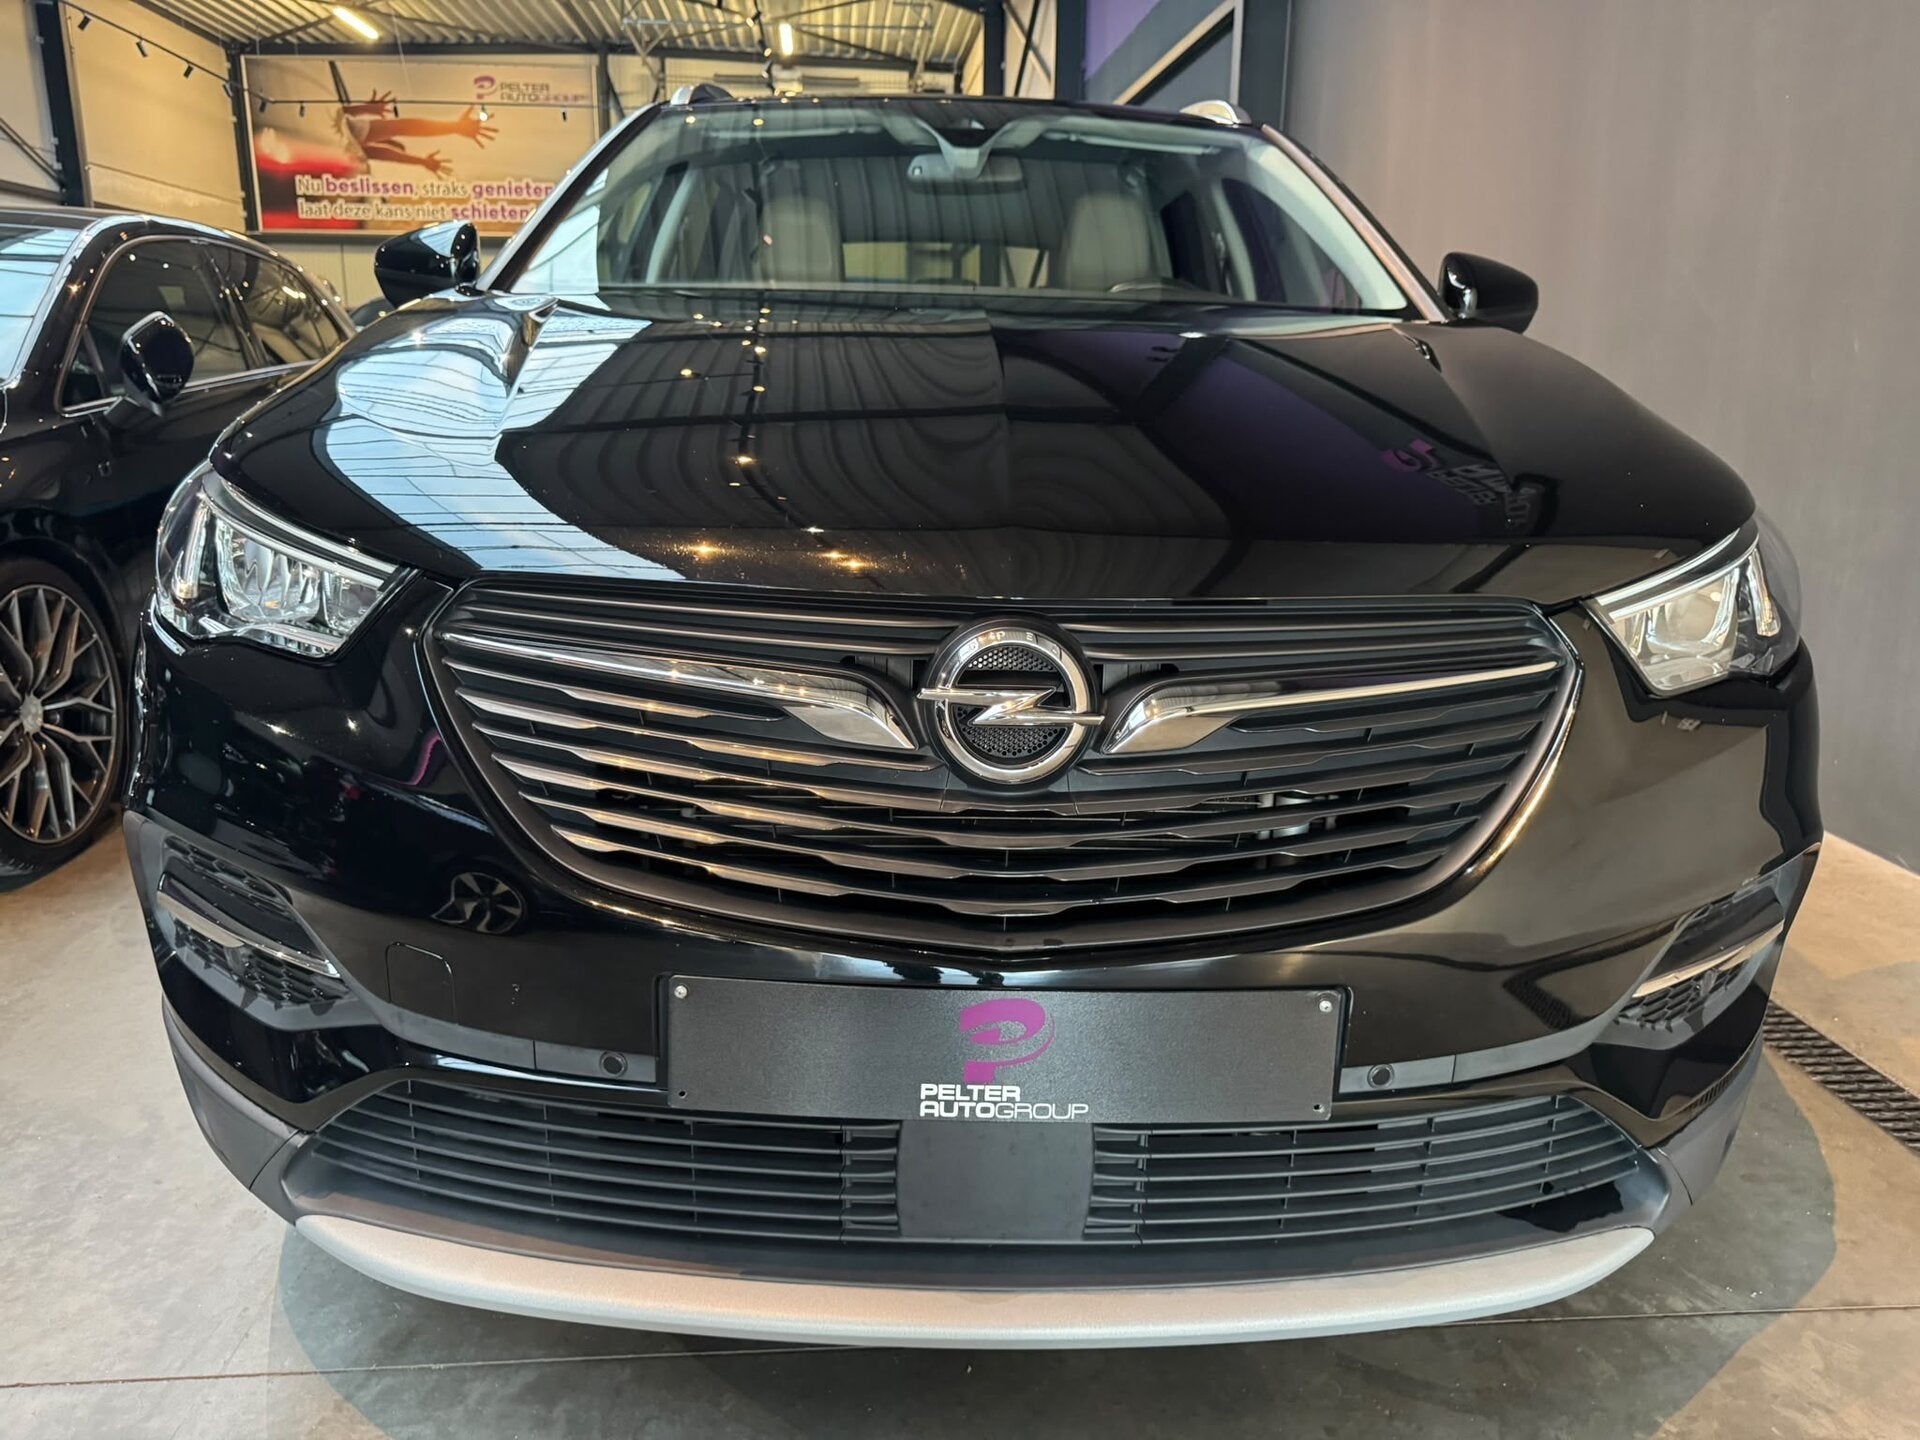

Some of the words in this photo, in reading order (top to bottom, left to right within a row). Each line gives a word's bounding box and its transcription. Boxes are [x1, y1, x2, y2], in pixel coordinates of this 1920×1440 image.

[500, 82, 550, 92] PELTER
[298, 177, 322, 193] Nu
[325, 177, 418, 196] beslissen,
[422, 182, 467, 197] straks
[300, 200, 331, 216] laat
[333, 201, 370, 217] deze
[375, 203, 413, 217] kans
[416, 205, 446, 218] niet
[920, 1083, 1021, 1101] PELTER
[919, 1101, 1089, 1120] AUTOGROUP
